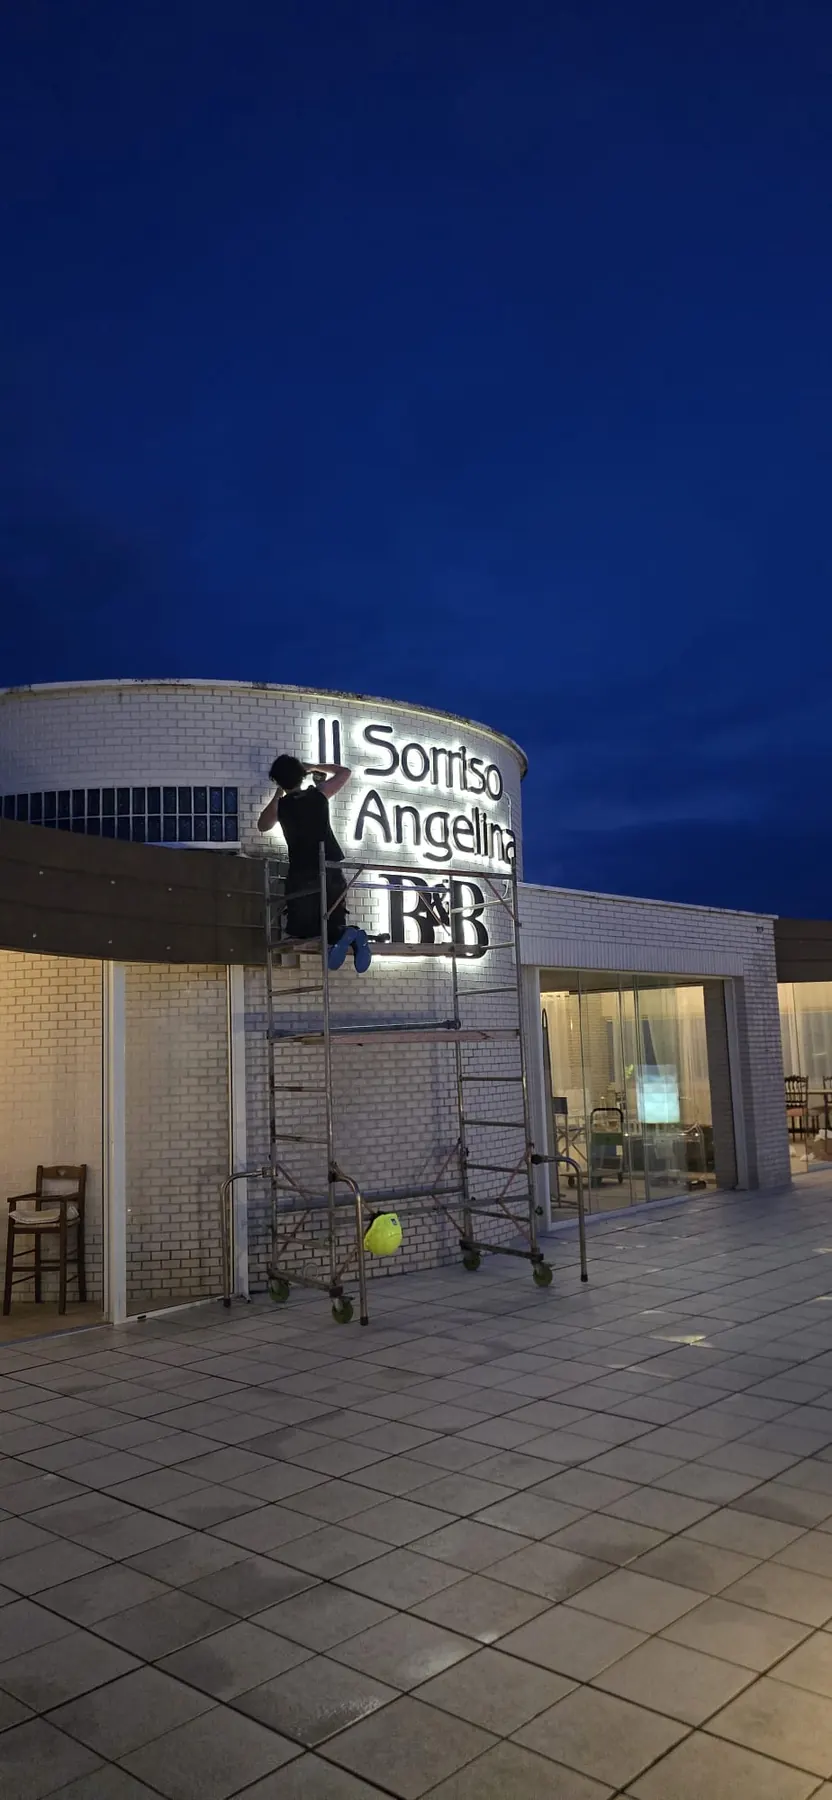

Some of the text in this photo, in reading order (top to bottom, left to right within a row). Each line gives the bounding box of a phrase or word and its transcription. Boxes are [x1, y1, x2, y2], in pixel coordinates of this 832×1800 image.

[318, 718, 503, 801] Il Sorriso
[354, 789, 516, 864] Angelina
[378, 873, 490, 960] B&B
